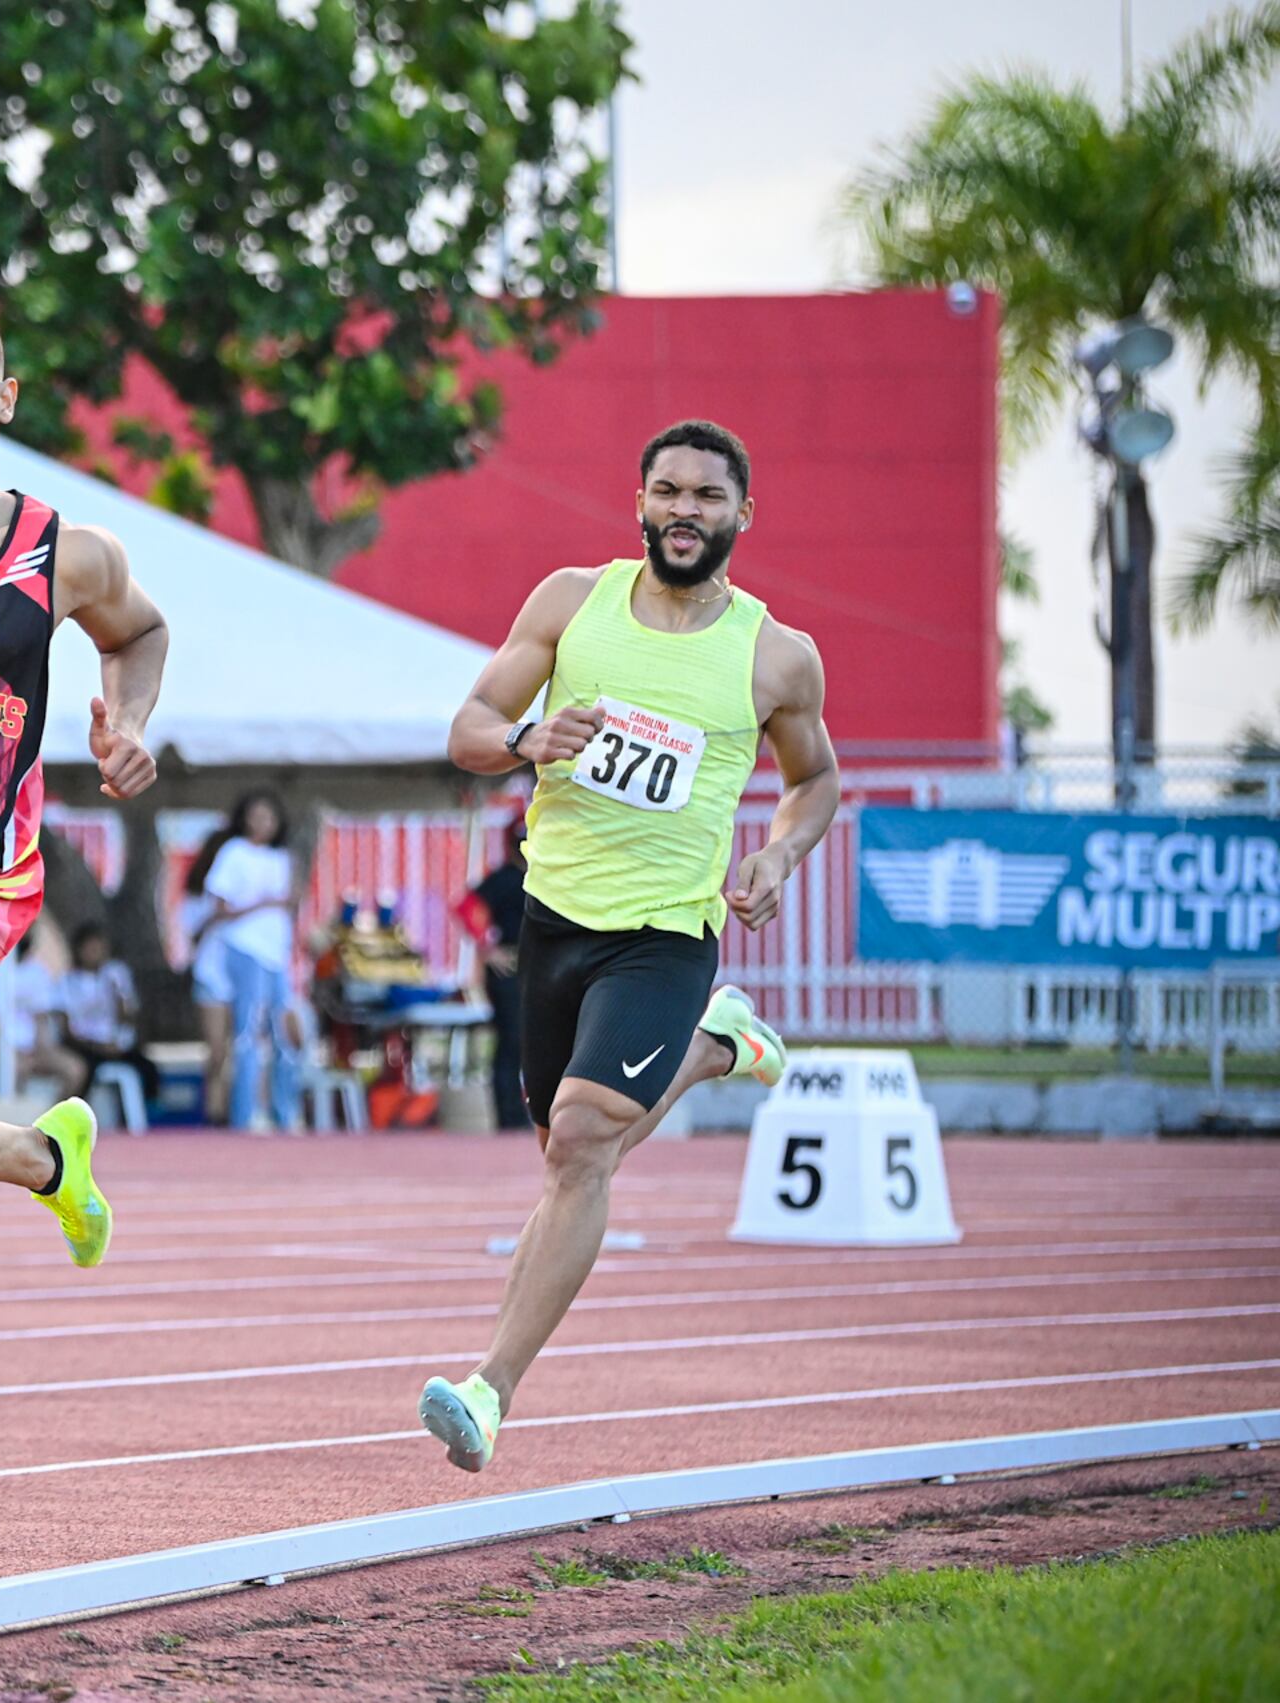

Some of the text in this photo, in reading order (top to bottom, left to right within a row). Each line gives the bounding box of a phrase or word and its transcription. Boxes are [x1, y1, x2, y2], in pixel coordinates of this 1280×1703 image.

[628, 710, 669, 733] CAROLINA
[630, 724, 658, 742] BREAK
[658, 734, 694, 754] CLASSIC
[591, 732, 678, 804] 370
[777, 1136, 824, 1210] 5
[884, 1136, 918, 1210] 5
